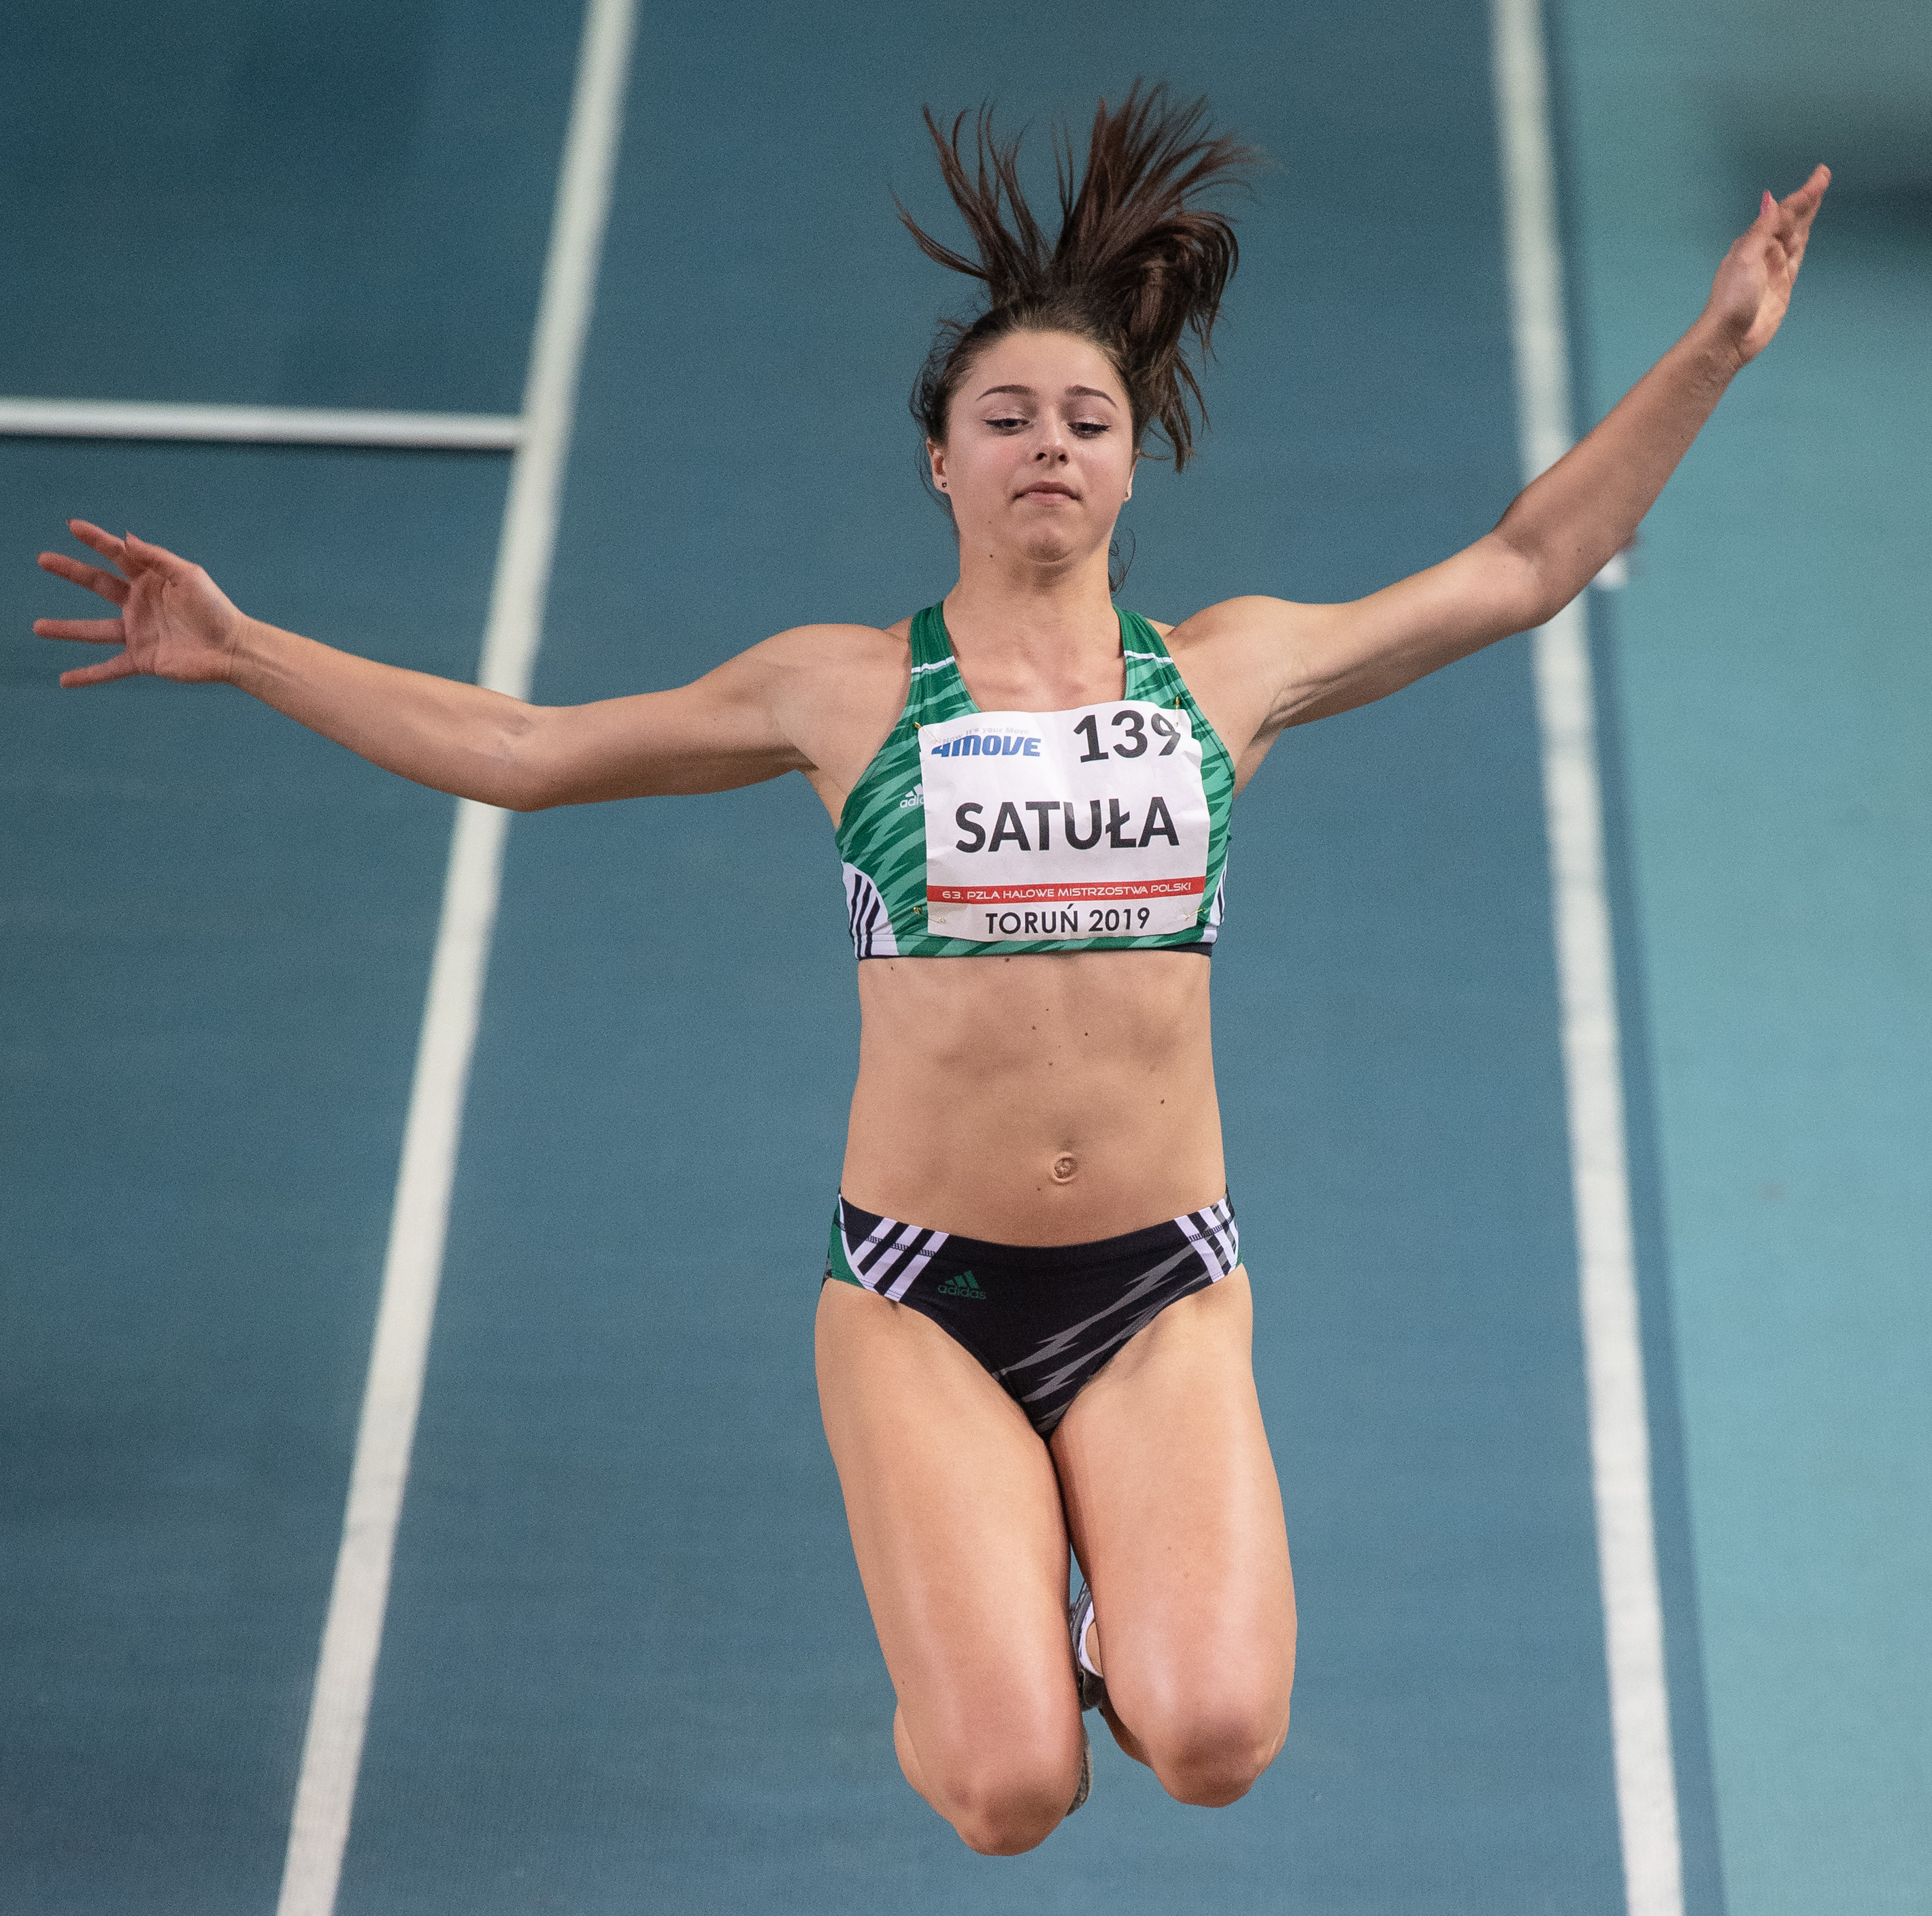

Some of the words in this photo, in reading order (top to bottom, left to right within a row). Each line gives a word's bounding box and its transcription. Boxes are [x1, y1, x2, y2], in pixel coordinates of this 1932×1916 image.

[943, 733, 963, 744] Now
[1073, 710, 1181, 763] 139
[955, 797, 1180, 853] SATUŁA
[942, 891, 964, 899] 63.
[967, 891, 1000, 899] PZLA
[1003, 889, 1054, 899] HALOWE
[1058, 887, 1148, 897] MISTRZOSTWA
[1150, 882, 1191, 893] POLSKI
[985, 903, 1078, 935] TORUŃ
[1088, 907, 1150, 932] 2019
[937, 1285, 986, 1300] adidas
